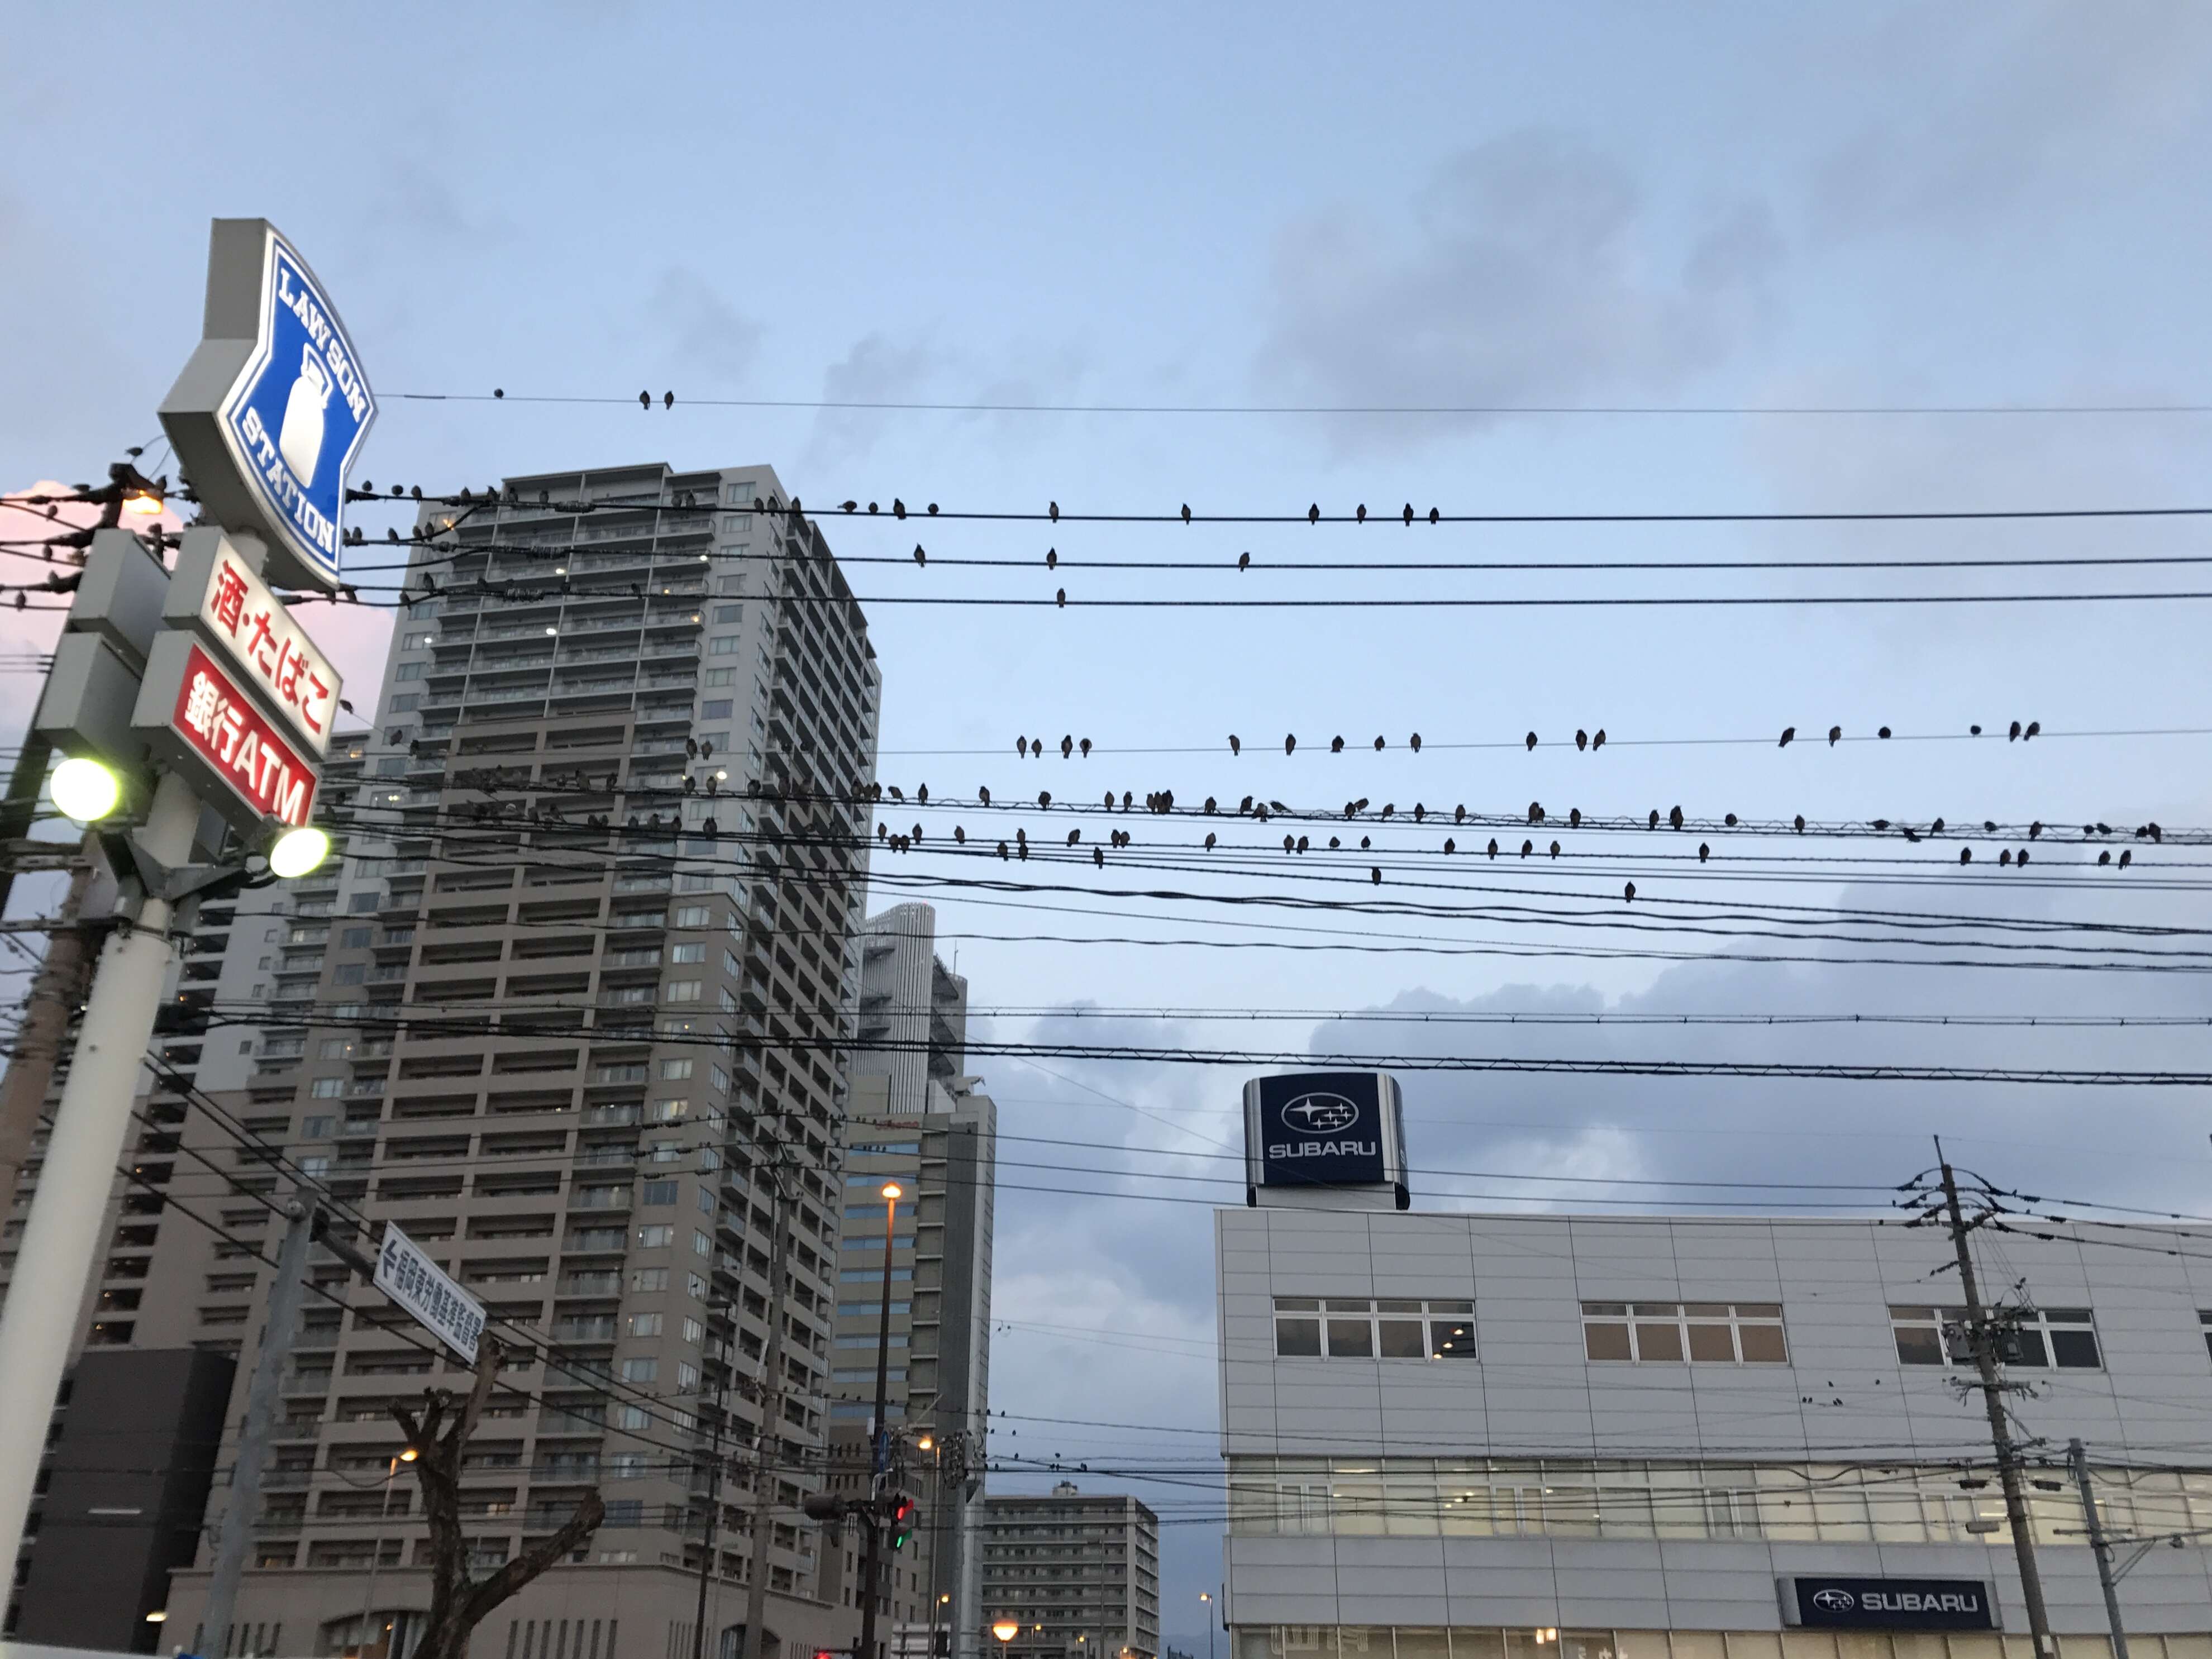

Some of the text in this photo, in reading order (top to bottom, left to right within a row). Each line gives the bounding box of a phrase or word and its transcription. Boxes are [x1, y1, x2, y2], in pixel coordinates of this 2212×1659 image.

[279, 268, 366, 423] LAWSON
[242, 406, 334, 555] STATION
[212, 560, 328, 734] 酒・たばこ
[185, 671, 305, 825] 銀行ATM
[1269, 1141, 1376, 1159] SUBARU
[1861, 1593, 1979, 1612] SUBARU
